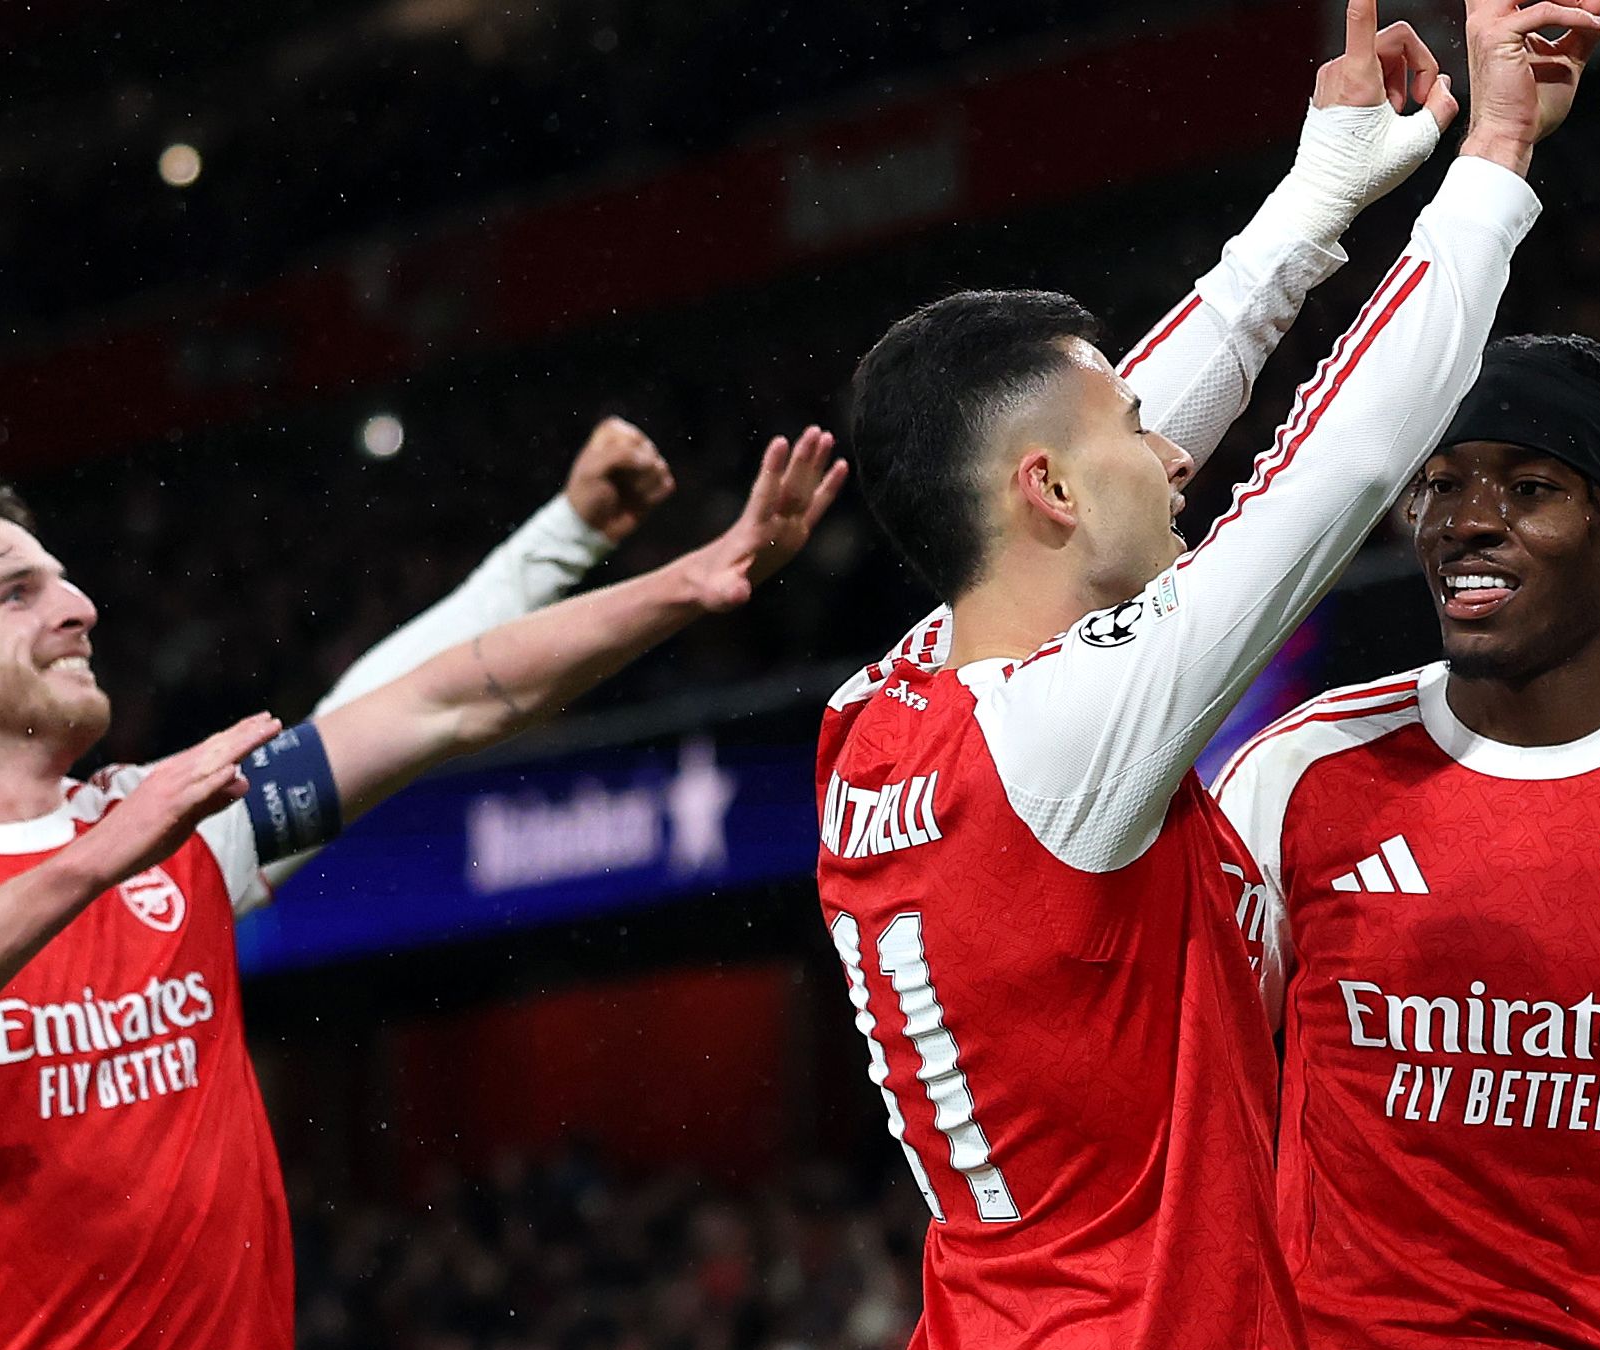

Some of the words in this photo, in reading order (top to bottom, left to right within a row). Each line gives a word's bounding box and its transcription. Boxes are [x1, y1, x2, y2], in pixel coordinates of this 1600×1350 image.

[38, 1056, 91, 1120] FLY
[96, 1036, 200, 1110] BETTER
[830, 911, 1021, 1223] 11
[1385, 1062, 1452, 1123] FLY
